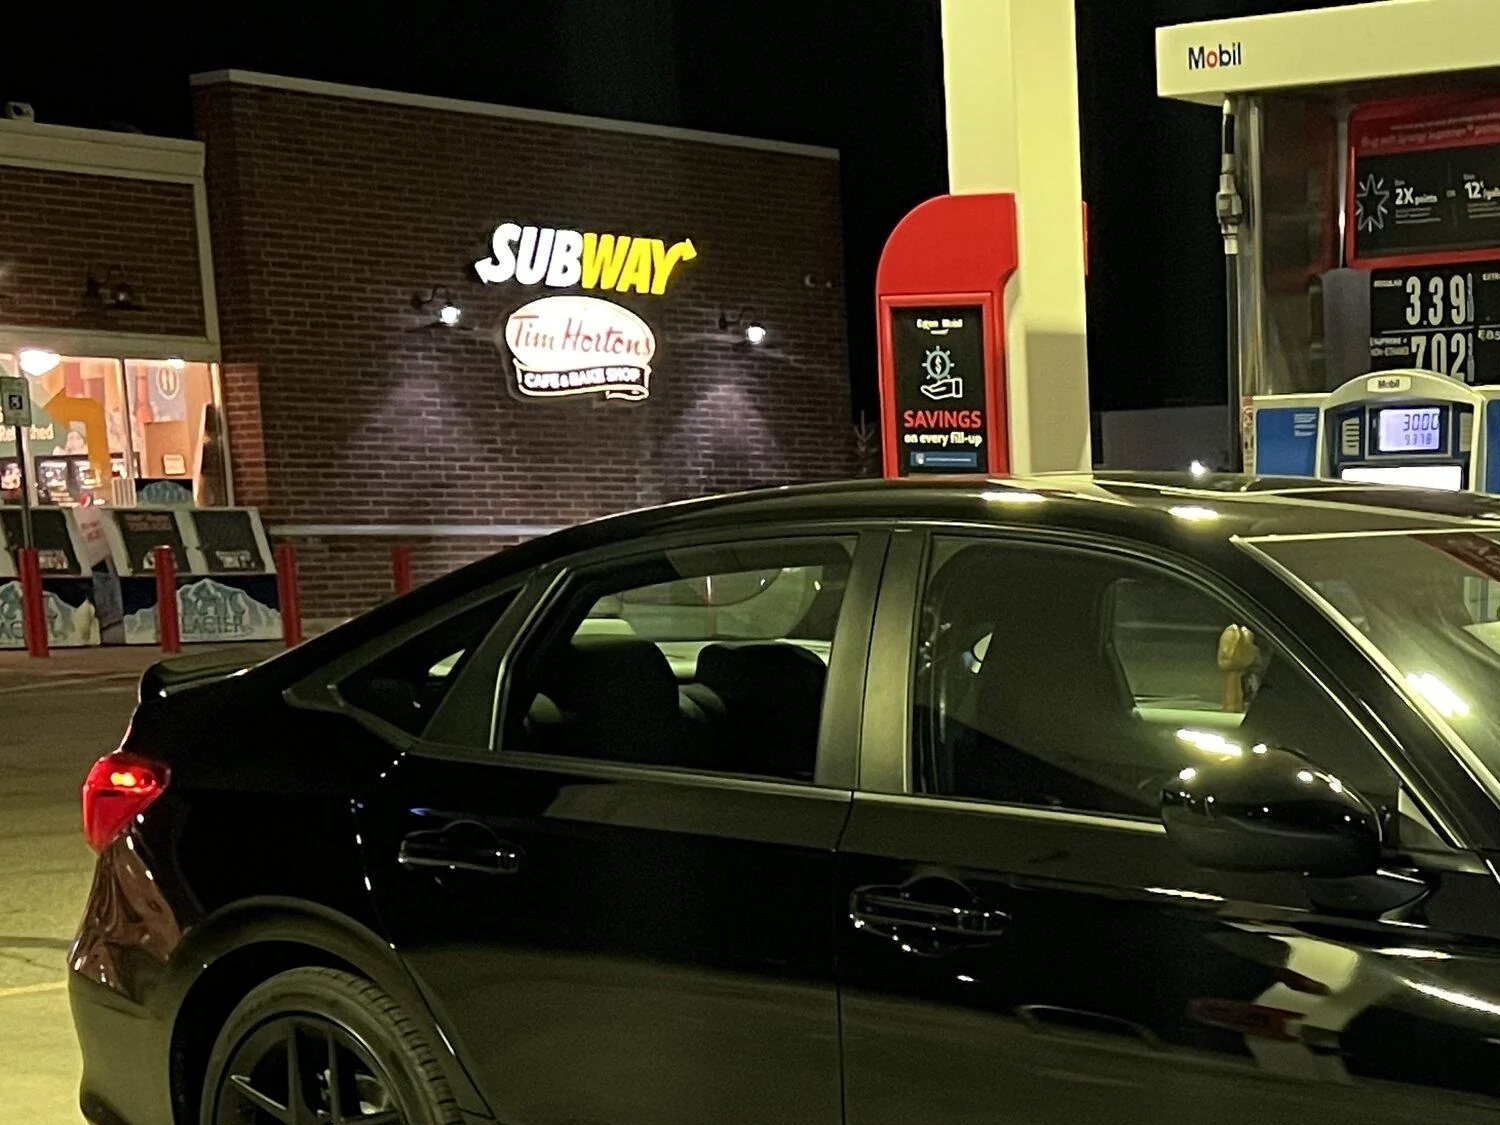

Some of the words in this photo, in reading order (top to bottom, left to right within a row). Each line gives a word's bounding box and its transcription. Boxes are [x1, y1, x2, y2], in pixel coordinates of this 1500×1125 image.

[1188, 41, 1242, 71] Mobil
[1395, 187, 1414, 206] 2X
[475, 222, 697, 296] SUBWAY
[511, 314, 555, 351] Tim
[561, 317, 651, 357] Hortons
[1377, 376, 1401, 389] Mobil
[903, 409, 982, 429] SAVINGS
[904, 433, 918, 444] on
[919, 433, 949, 447] every
